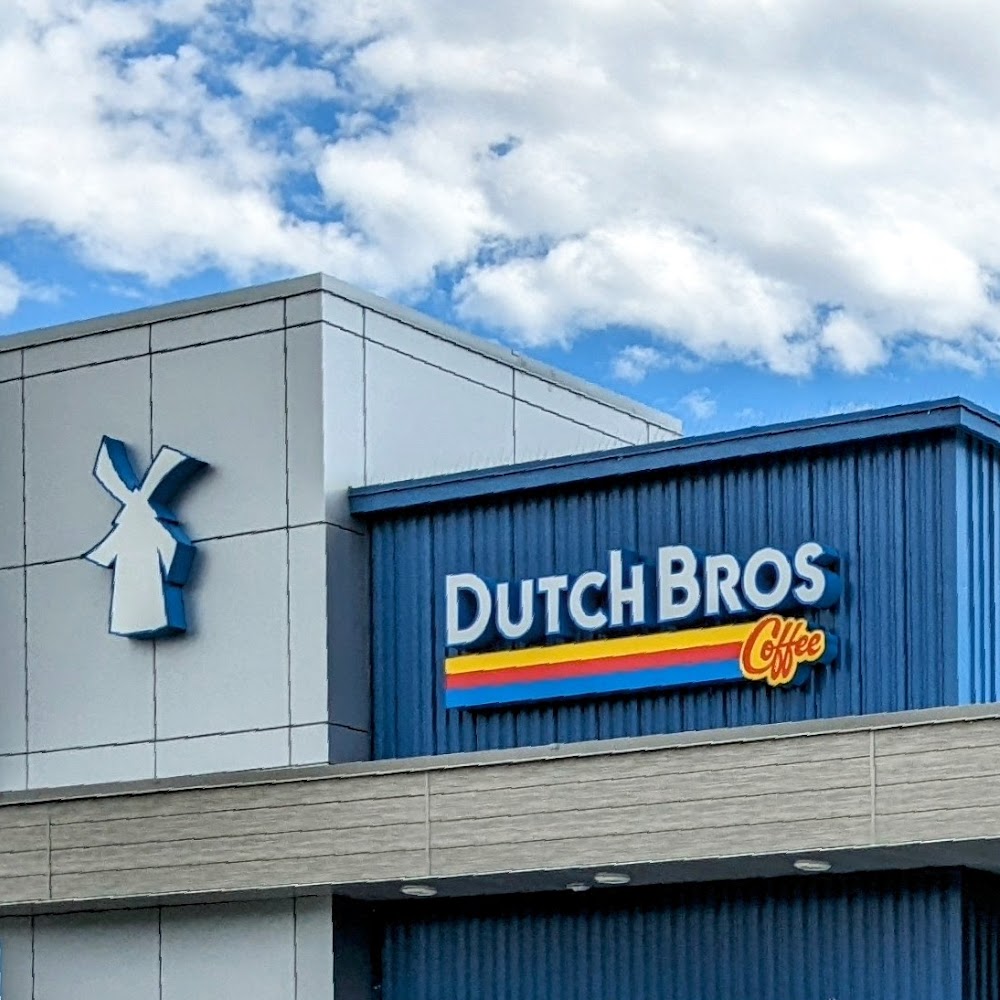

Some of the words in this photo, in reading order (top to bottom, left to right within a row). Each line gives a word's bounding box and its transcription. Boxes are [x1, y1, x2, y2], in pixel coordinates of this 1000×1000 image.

[445, 549, 645, 648] DUTCH
[657, 542, 826, 623] BROS
[742, 616, 823, 681] Coffee
